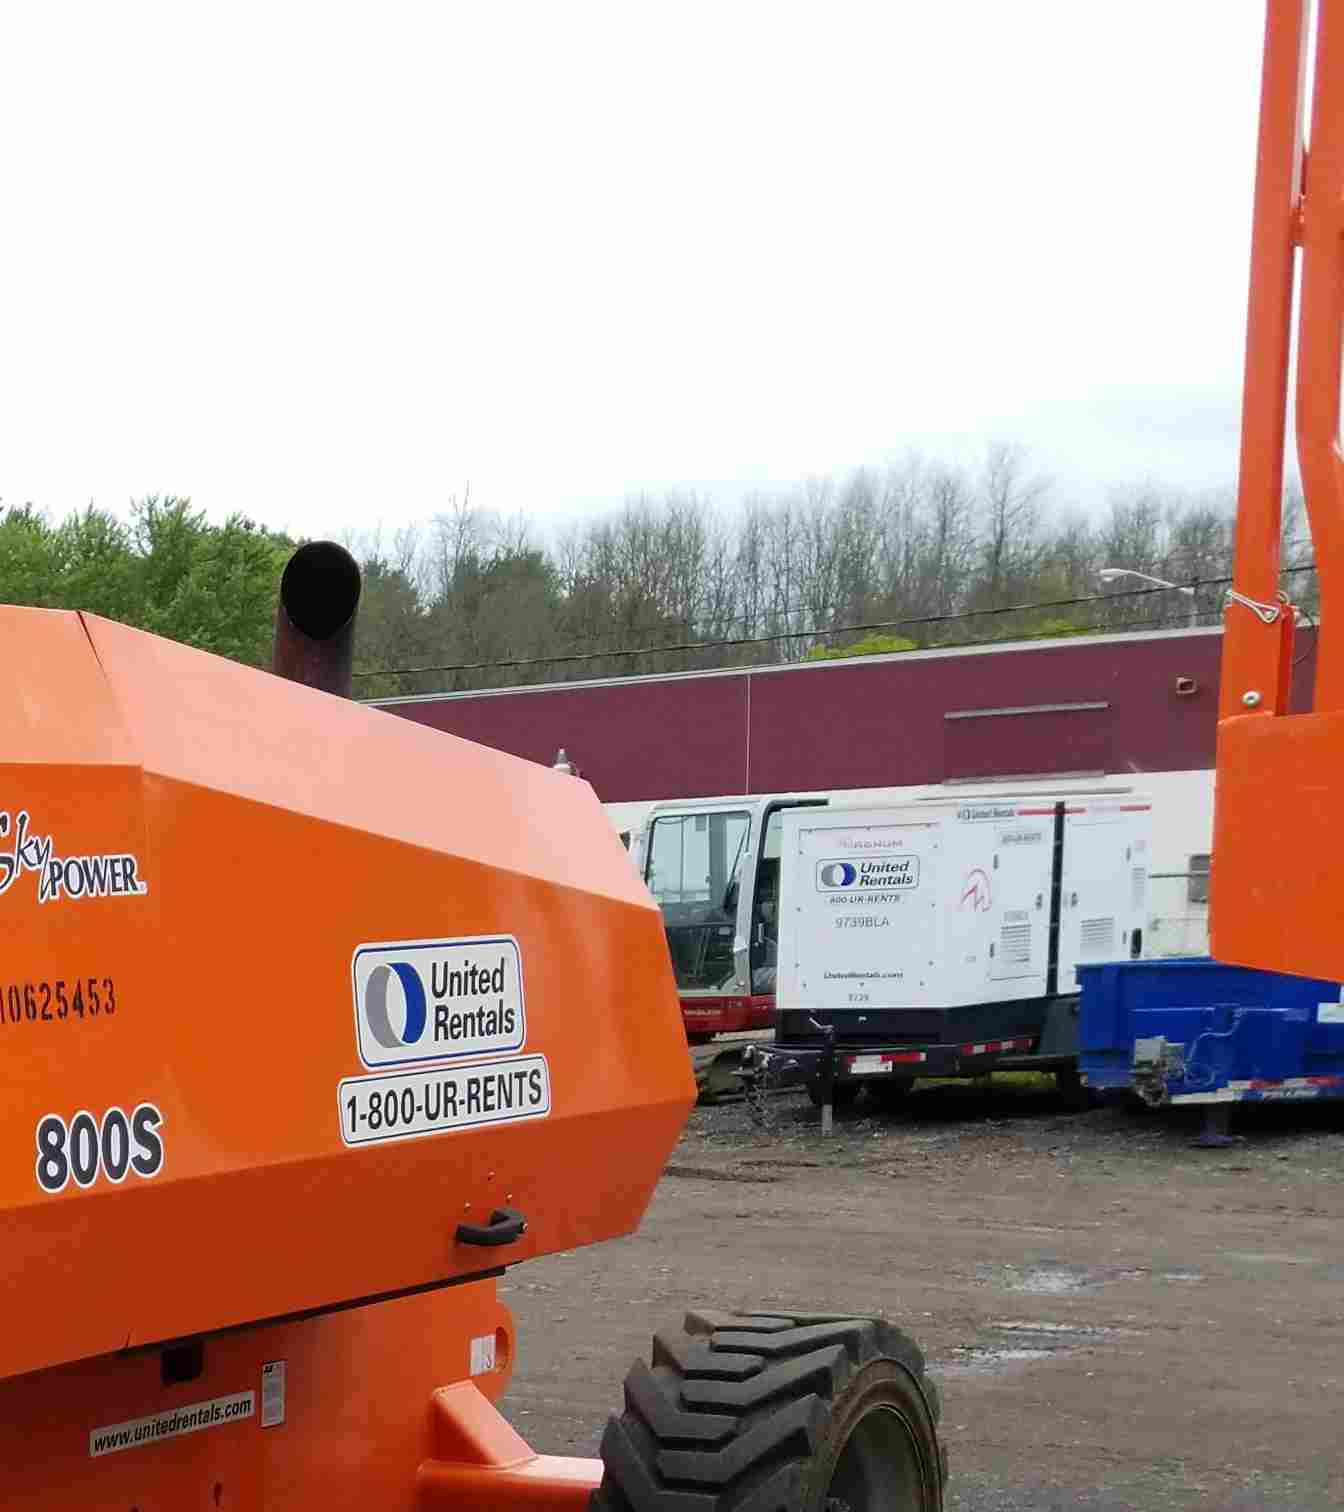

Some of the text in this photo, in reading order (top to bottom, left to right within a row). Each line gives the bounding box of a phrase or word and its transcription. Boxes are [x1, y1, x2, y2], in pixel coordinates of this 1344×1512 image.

[860, 860, 911, 874] United
[860, 873, 914, 888] Rentals
[431, 956, 507, 1001] United
[433, 1003, 516, 1043] Rentals
[346, 1068, 543, 1134] 1-800-UR-RENTS
[37, 1106, 163, 1191] 800S
[93, 1398, 252, 1452] www.unitedrentals.com
